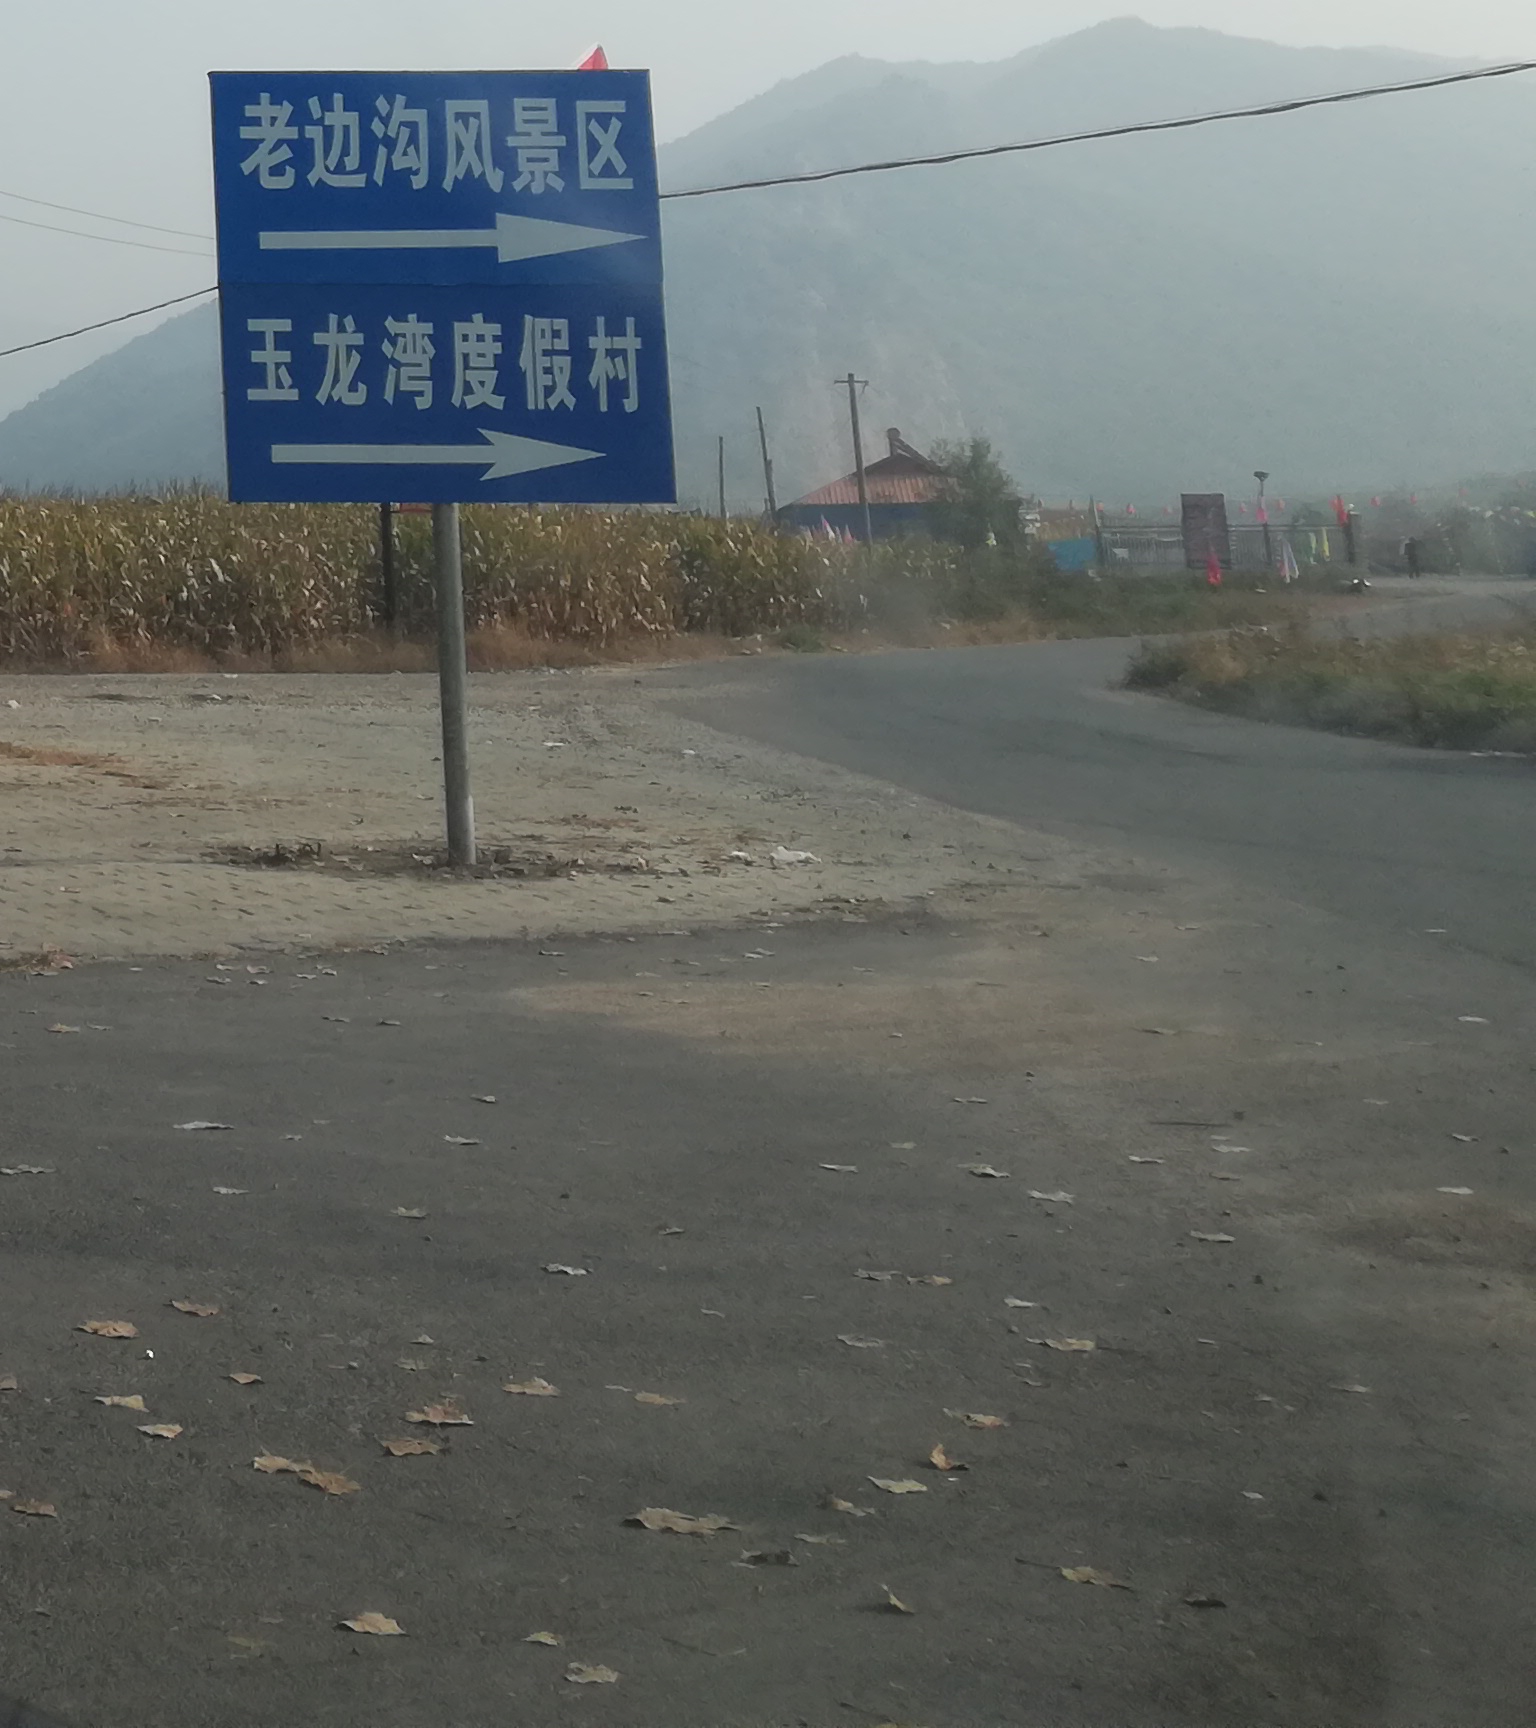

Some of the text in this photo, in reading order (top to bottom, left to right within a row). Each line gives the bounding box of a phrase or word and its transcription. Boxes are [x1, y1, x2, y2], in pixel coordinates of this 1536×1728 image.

[238, 92, 634, 194] 老边沟风景区
[246, 312, 642, 413] 玉龙湾度假村
